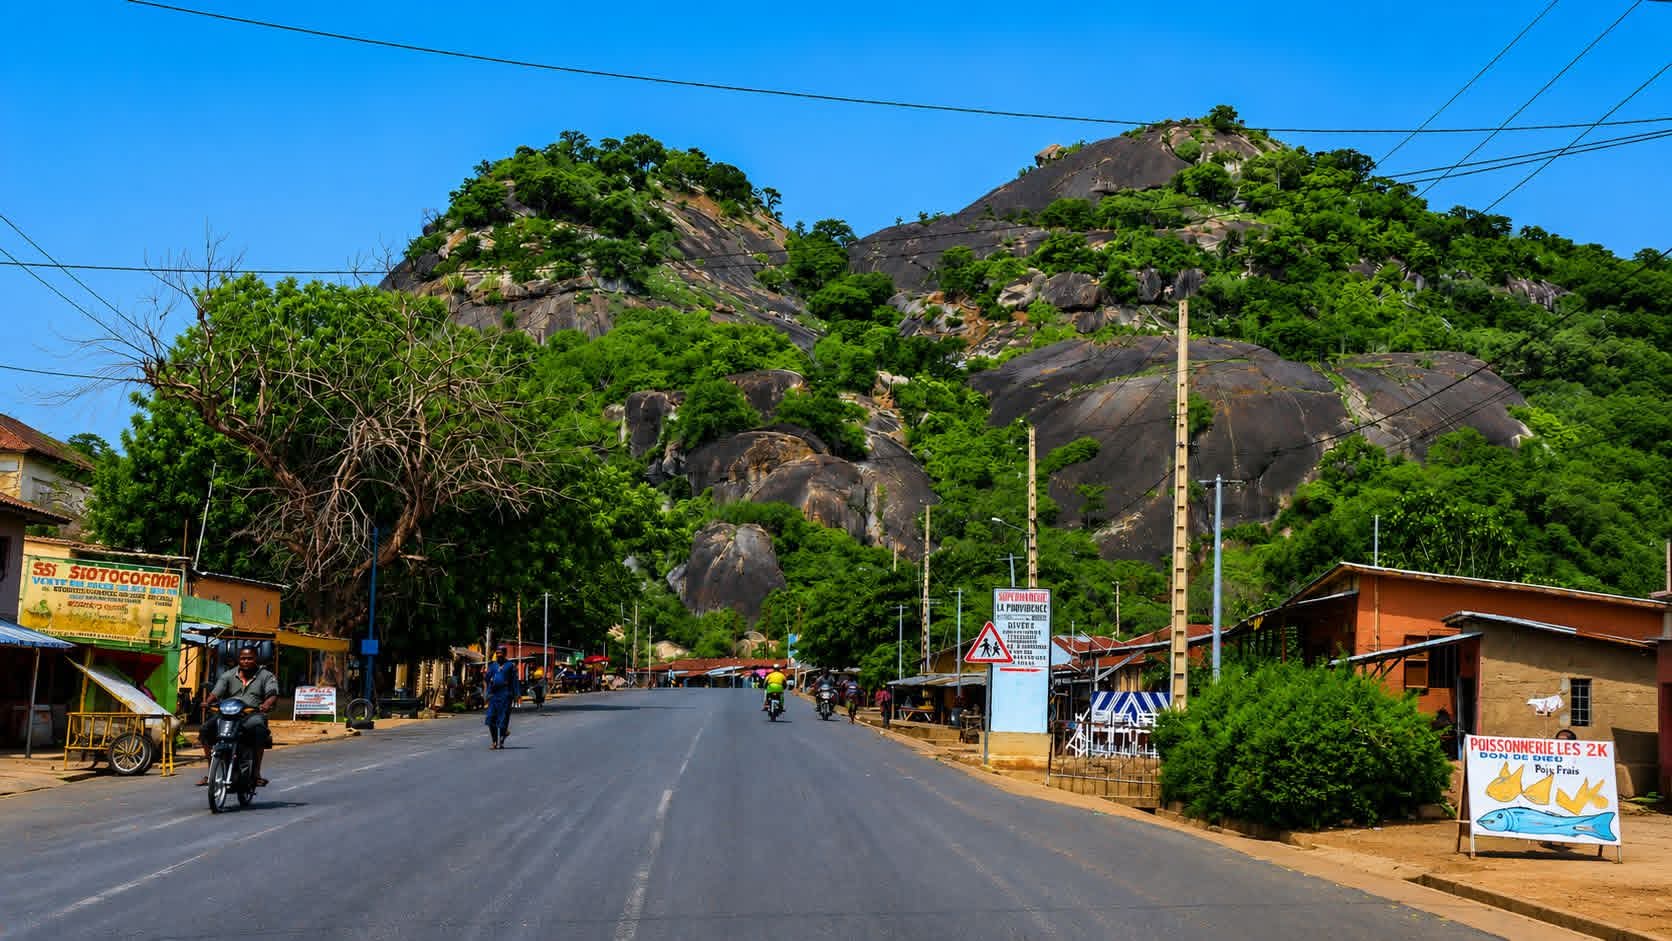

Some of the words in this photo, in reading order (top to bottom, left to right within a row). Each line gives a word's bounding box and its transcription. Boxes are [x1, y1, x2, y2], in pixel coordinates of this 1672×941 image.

[1470, 737, 1554, 754] POISSONNERIE
[1557, 743, 1581, 756] LES
[1586, 743, 1608, 757] 2K
[1532, 755, 1564, 763] DIEU
[1556, 766, 1580, 775] Frais
